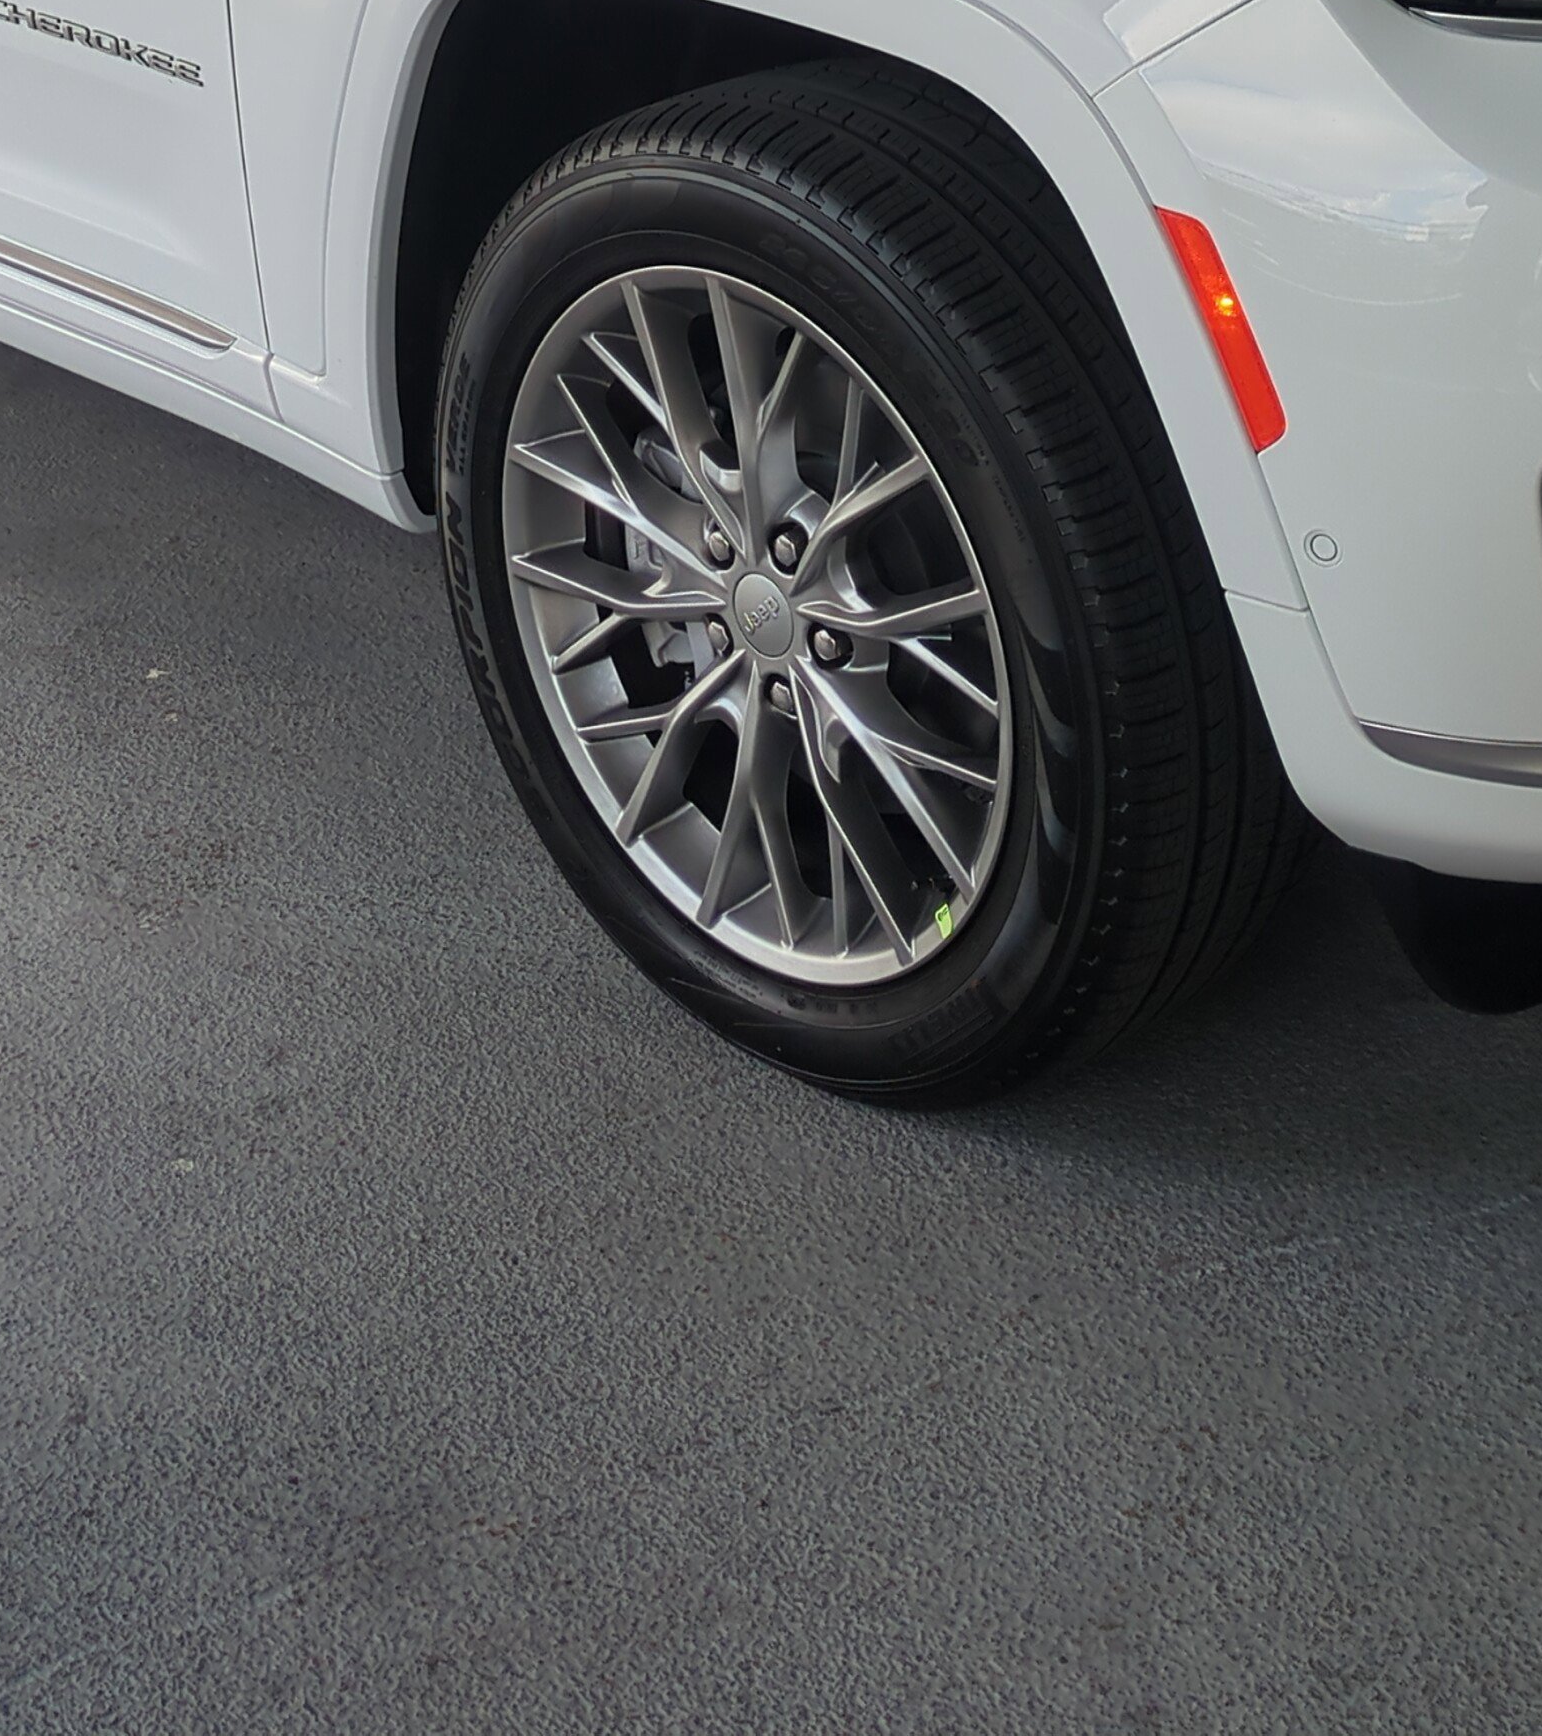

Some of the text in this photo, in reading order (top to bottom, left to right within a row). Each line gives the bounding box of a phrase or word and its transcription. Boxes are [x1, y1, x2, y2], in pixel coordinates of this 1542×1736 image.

[445, 350, 555, 826] SCORPION VERDE
[743, 595, 779, 634] Jeep
